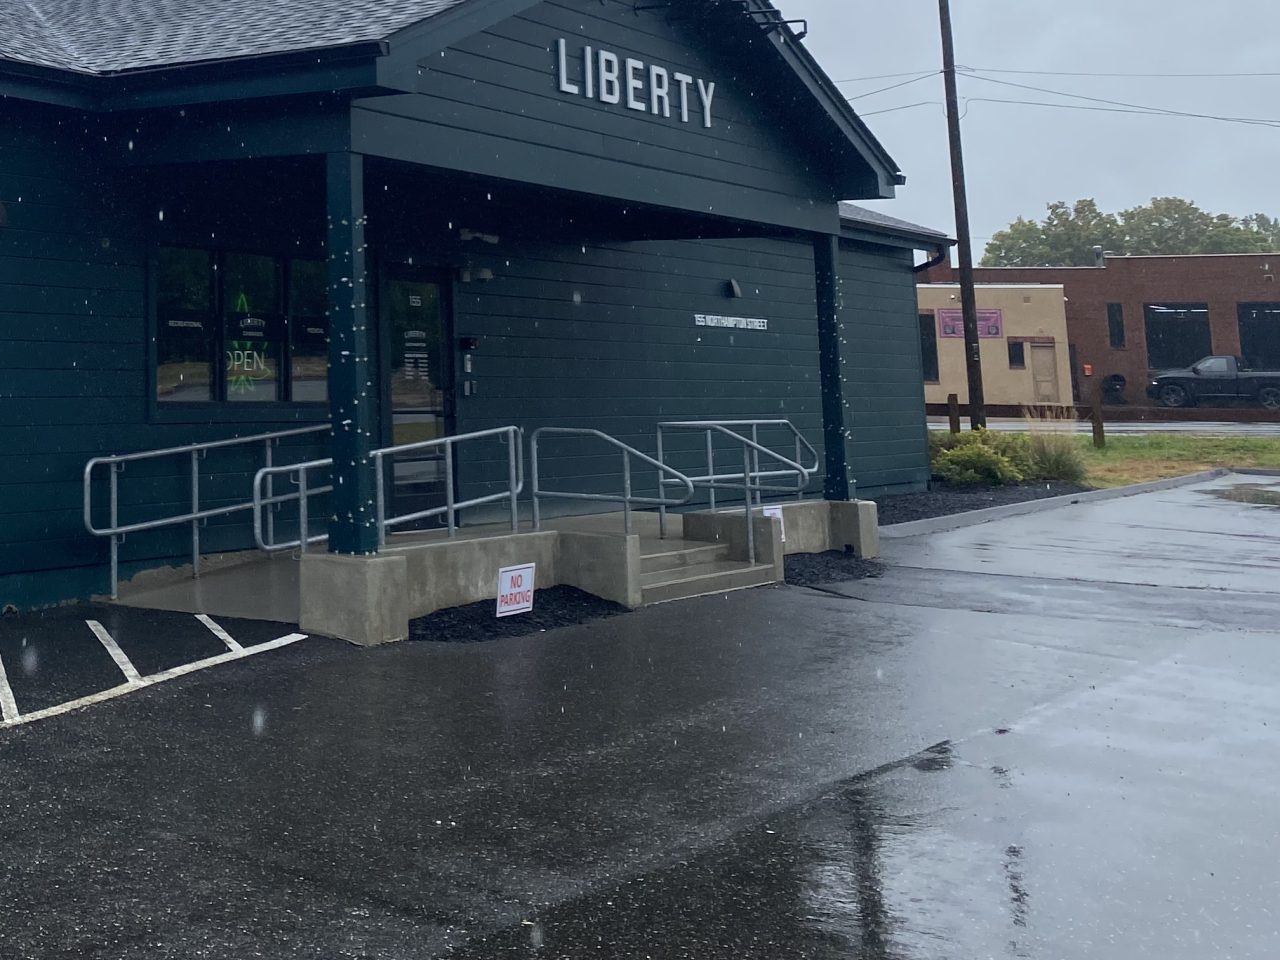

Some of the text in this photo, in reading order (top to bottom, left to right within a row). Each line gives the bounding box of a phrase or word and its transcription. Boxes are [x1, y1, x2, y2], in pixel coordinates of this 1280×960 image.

[557, 38, 715, 128] LIBERTY
[239, 318, 266, 328] LIBERTY
[694, 314, 706, 326] 155
[510, 574, 523, 589] NO
[500, 589, 531, 607] PARKING
